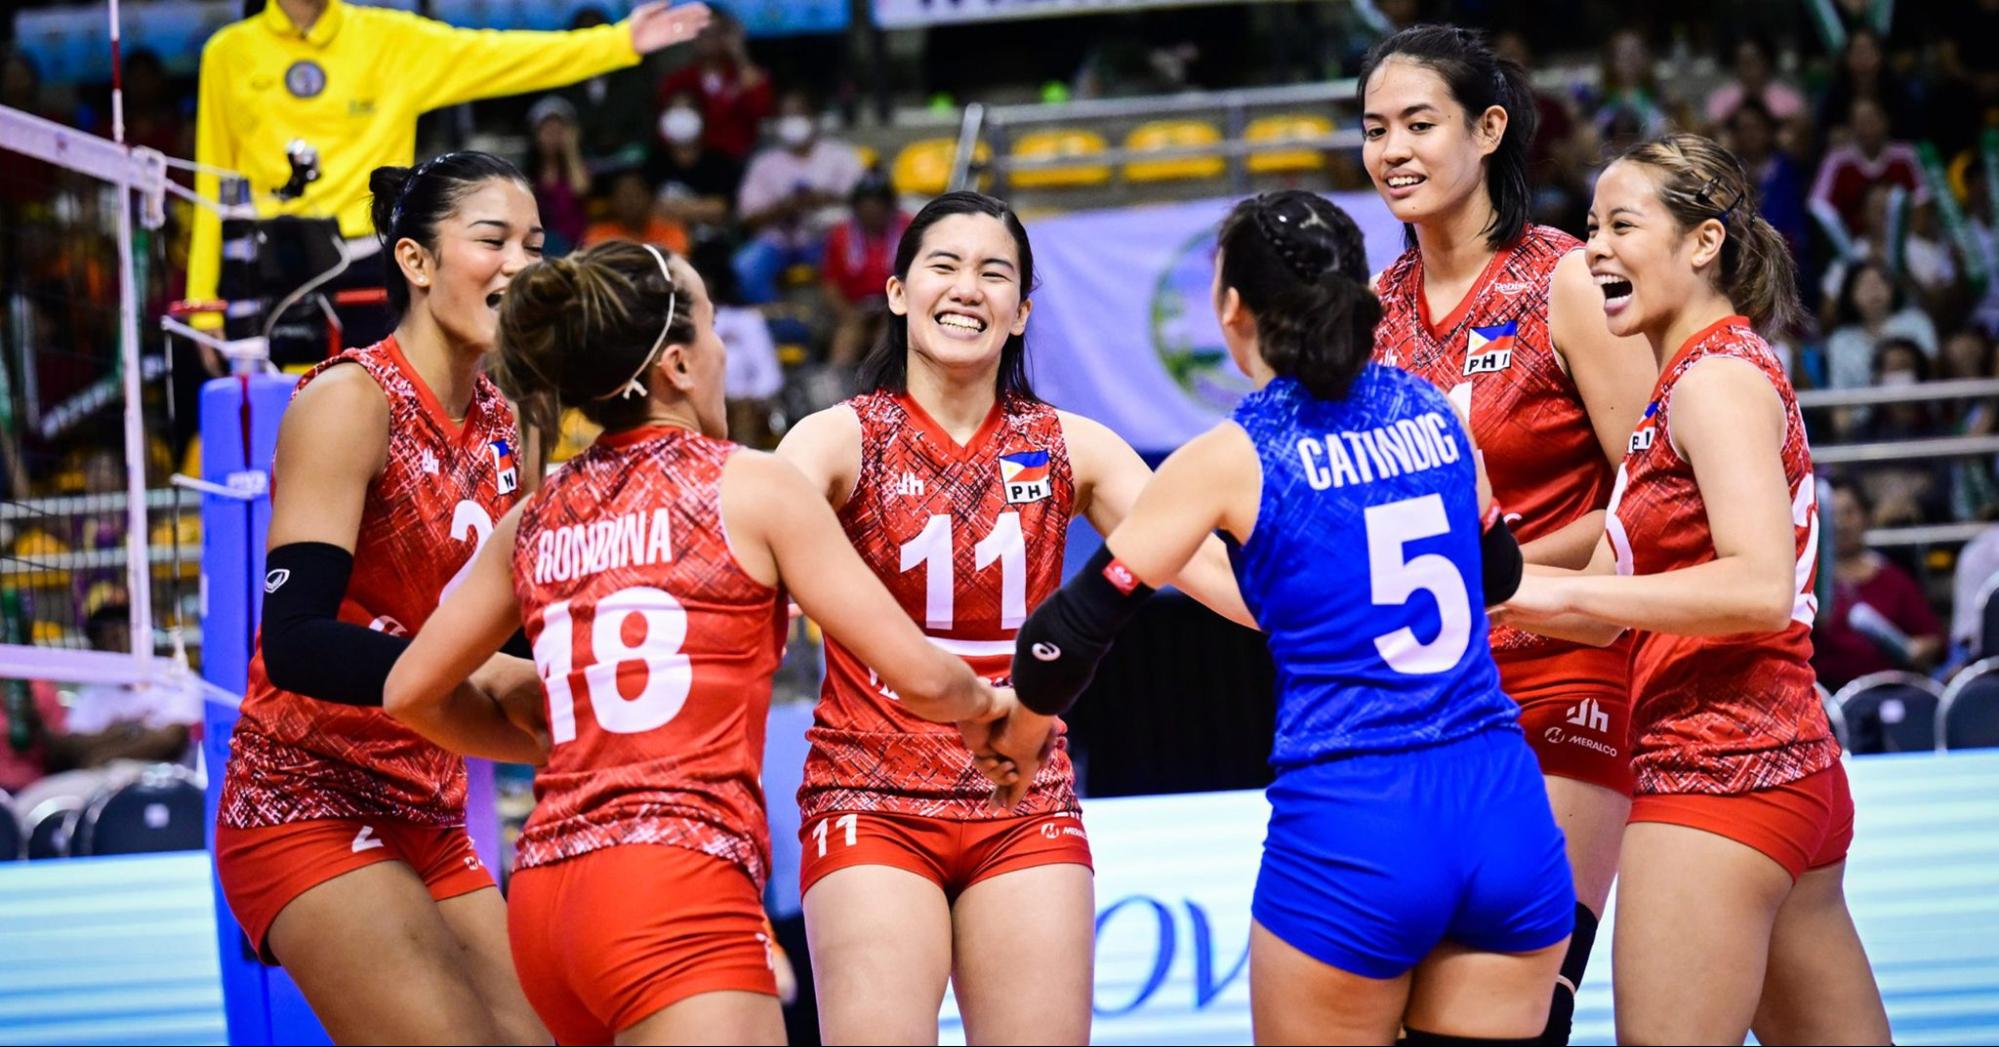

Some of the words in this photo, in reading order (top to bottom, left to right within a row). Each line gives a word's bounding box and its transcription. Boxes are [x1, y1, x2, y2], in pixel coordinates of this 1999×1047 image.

[1297, 412, 1461, 491] CATINDIG
[535, 507, 673, 585] RONDINA
[899, 511, 1027, 631] 11
[1363, 492, 1473, 676] 5
[532, 585, 694, 746] 18
[1568, 735, 1618, 758] MERALCO
[812, 813, 859, 859] 11
